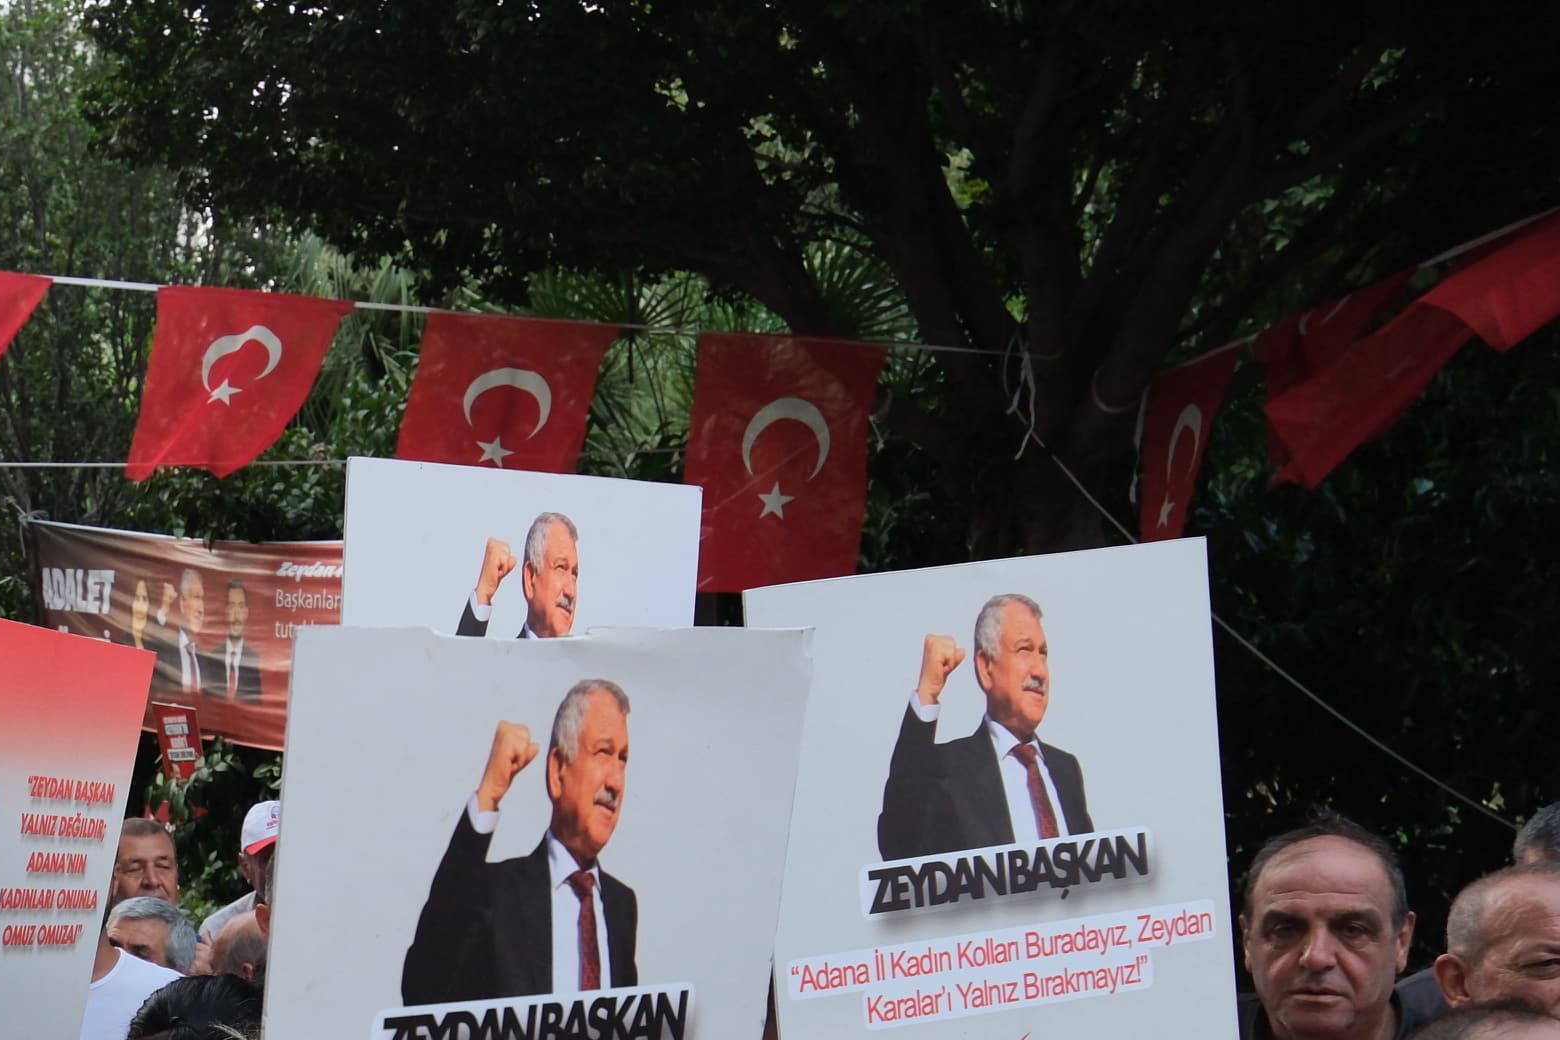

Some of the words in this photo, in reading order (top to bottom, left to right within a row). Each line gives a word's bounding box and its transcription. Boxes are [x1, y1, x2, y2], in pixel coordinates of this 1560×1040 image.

[41, 567, 115, 615] ADALET
[28, 775, 73, 800] “ZEYDAN
[74, 782, 115, 808] BAŞKAN
[20, 813, 58, 835] YALNIZ
[26, 851, 87, 874] ADANA'NIN
[868, 851, 1007, 915] ZEYDAN
[1008, 832, 1150, 900] BAŞKAN
[57, 889, 98, 910] ONUNLA
[2, 924, 36, 946] OMUZ
[791, 960, 870, 993] “Adana
[873, 949, 887, 982] İl
[890, 949, 952, 980] Kadın
[957, 937, 1020, 970] Kolları
[1024, 922, 1133, 959] Buradayız,
[1136, 908, 1213, 946] Zeydan
[866, 985, 953, 1024] Karalar’ı
[956, 977, 1020, 1010] Yalnız
[1023, 954, 1149, 1000] Bırakmayız!”
